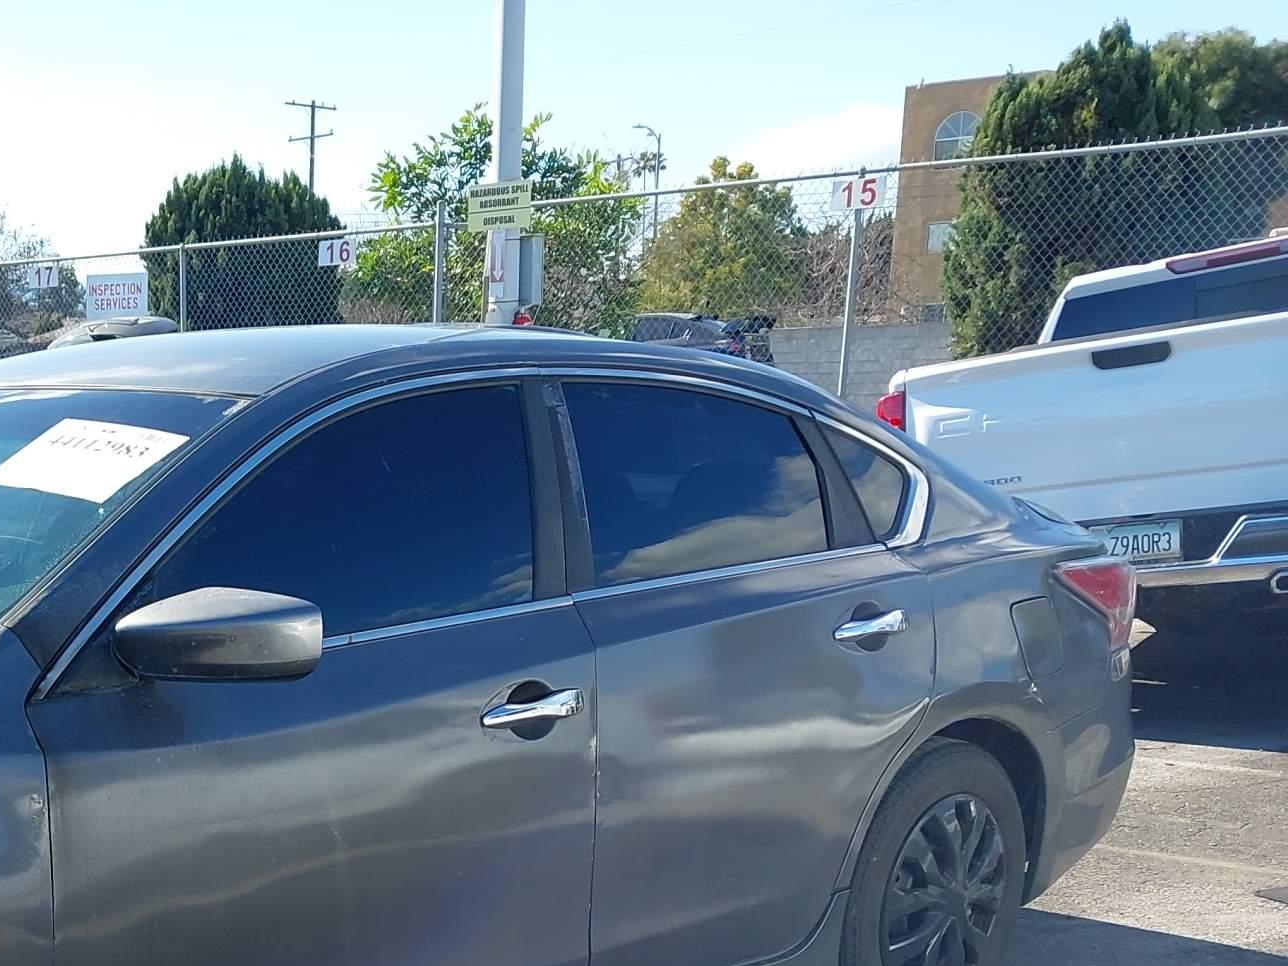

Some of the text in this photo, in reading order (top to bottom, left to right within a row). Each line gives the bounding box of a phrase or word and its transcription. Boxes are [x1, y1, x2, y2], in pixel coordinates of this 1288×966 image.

[470, 184, 529, 198] HAZARDOUS SPILL
[842, 178, 876, 208] 15
[483, 215, 515, 226] DISPOSAL
[327, 240, 350, 263] 16
[35, 266, 53, 286] 17
[88, 282, 142, 296] INSPECTION
[94, 297, 138, 311] SERVICES
